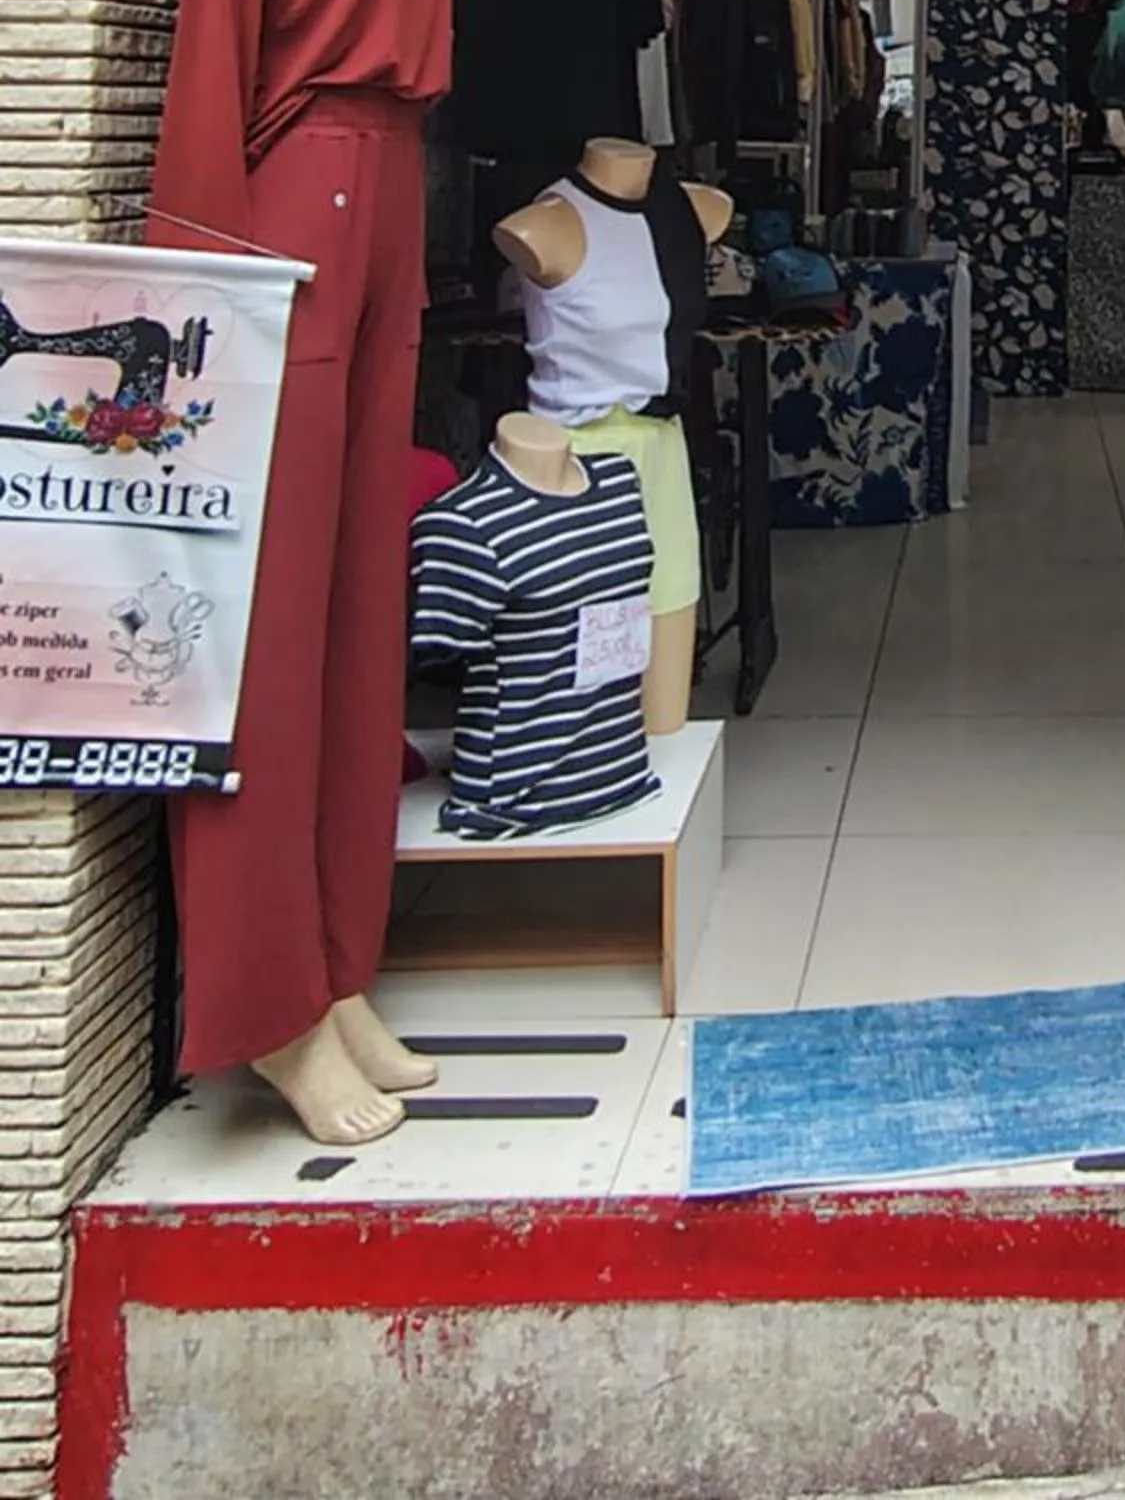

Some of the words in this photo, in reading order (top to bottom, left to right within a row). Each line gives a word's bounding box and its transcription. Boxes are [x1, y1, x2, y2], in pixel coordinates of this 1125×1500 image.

[0, 464, 235, 521] stureira
[22, 631, 89, 650] medida
[13, 666, 41, 678] em
[45, 662, 92, 682] geral
